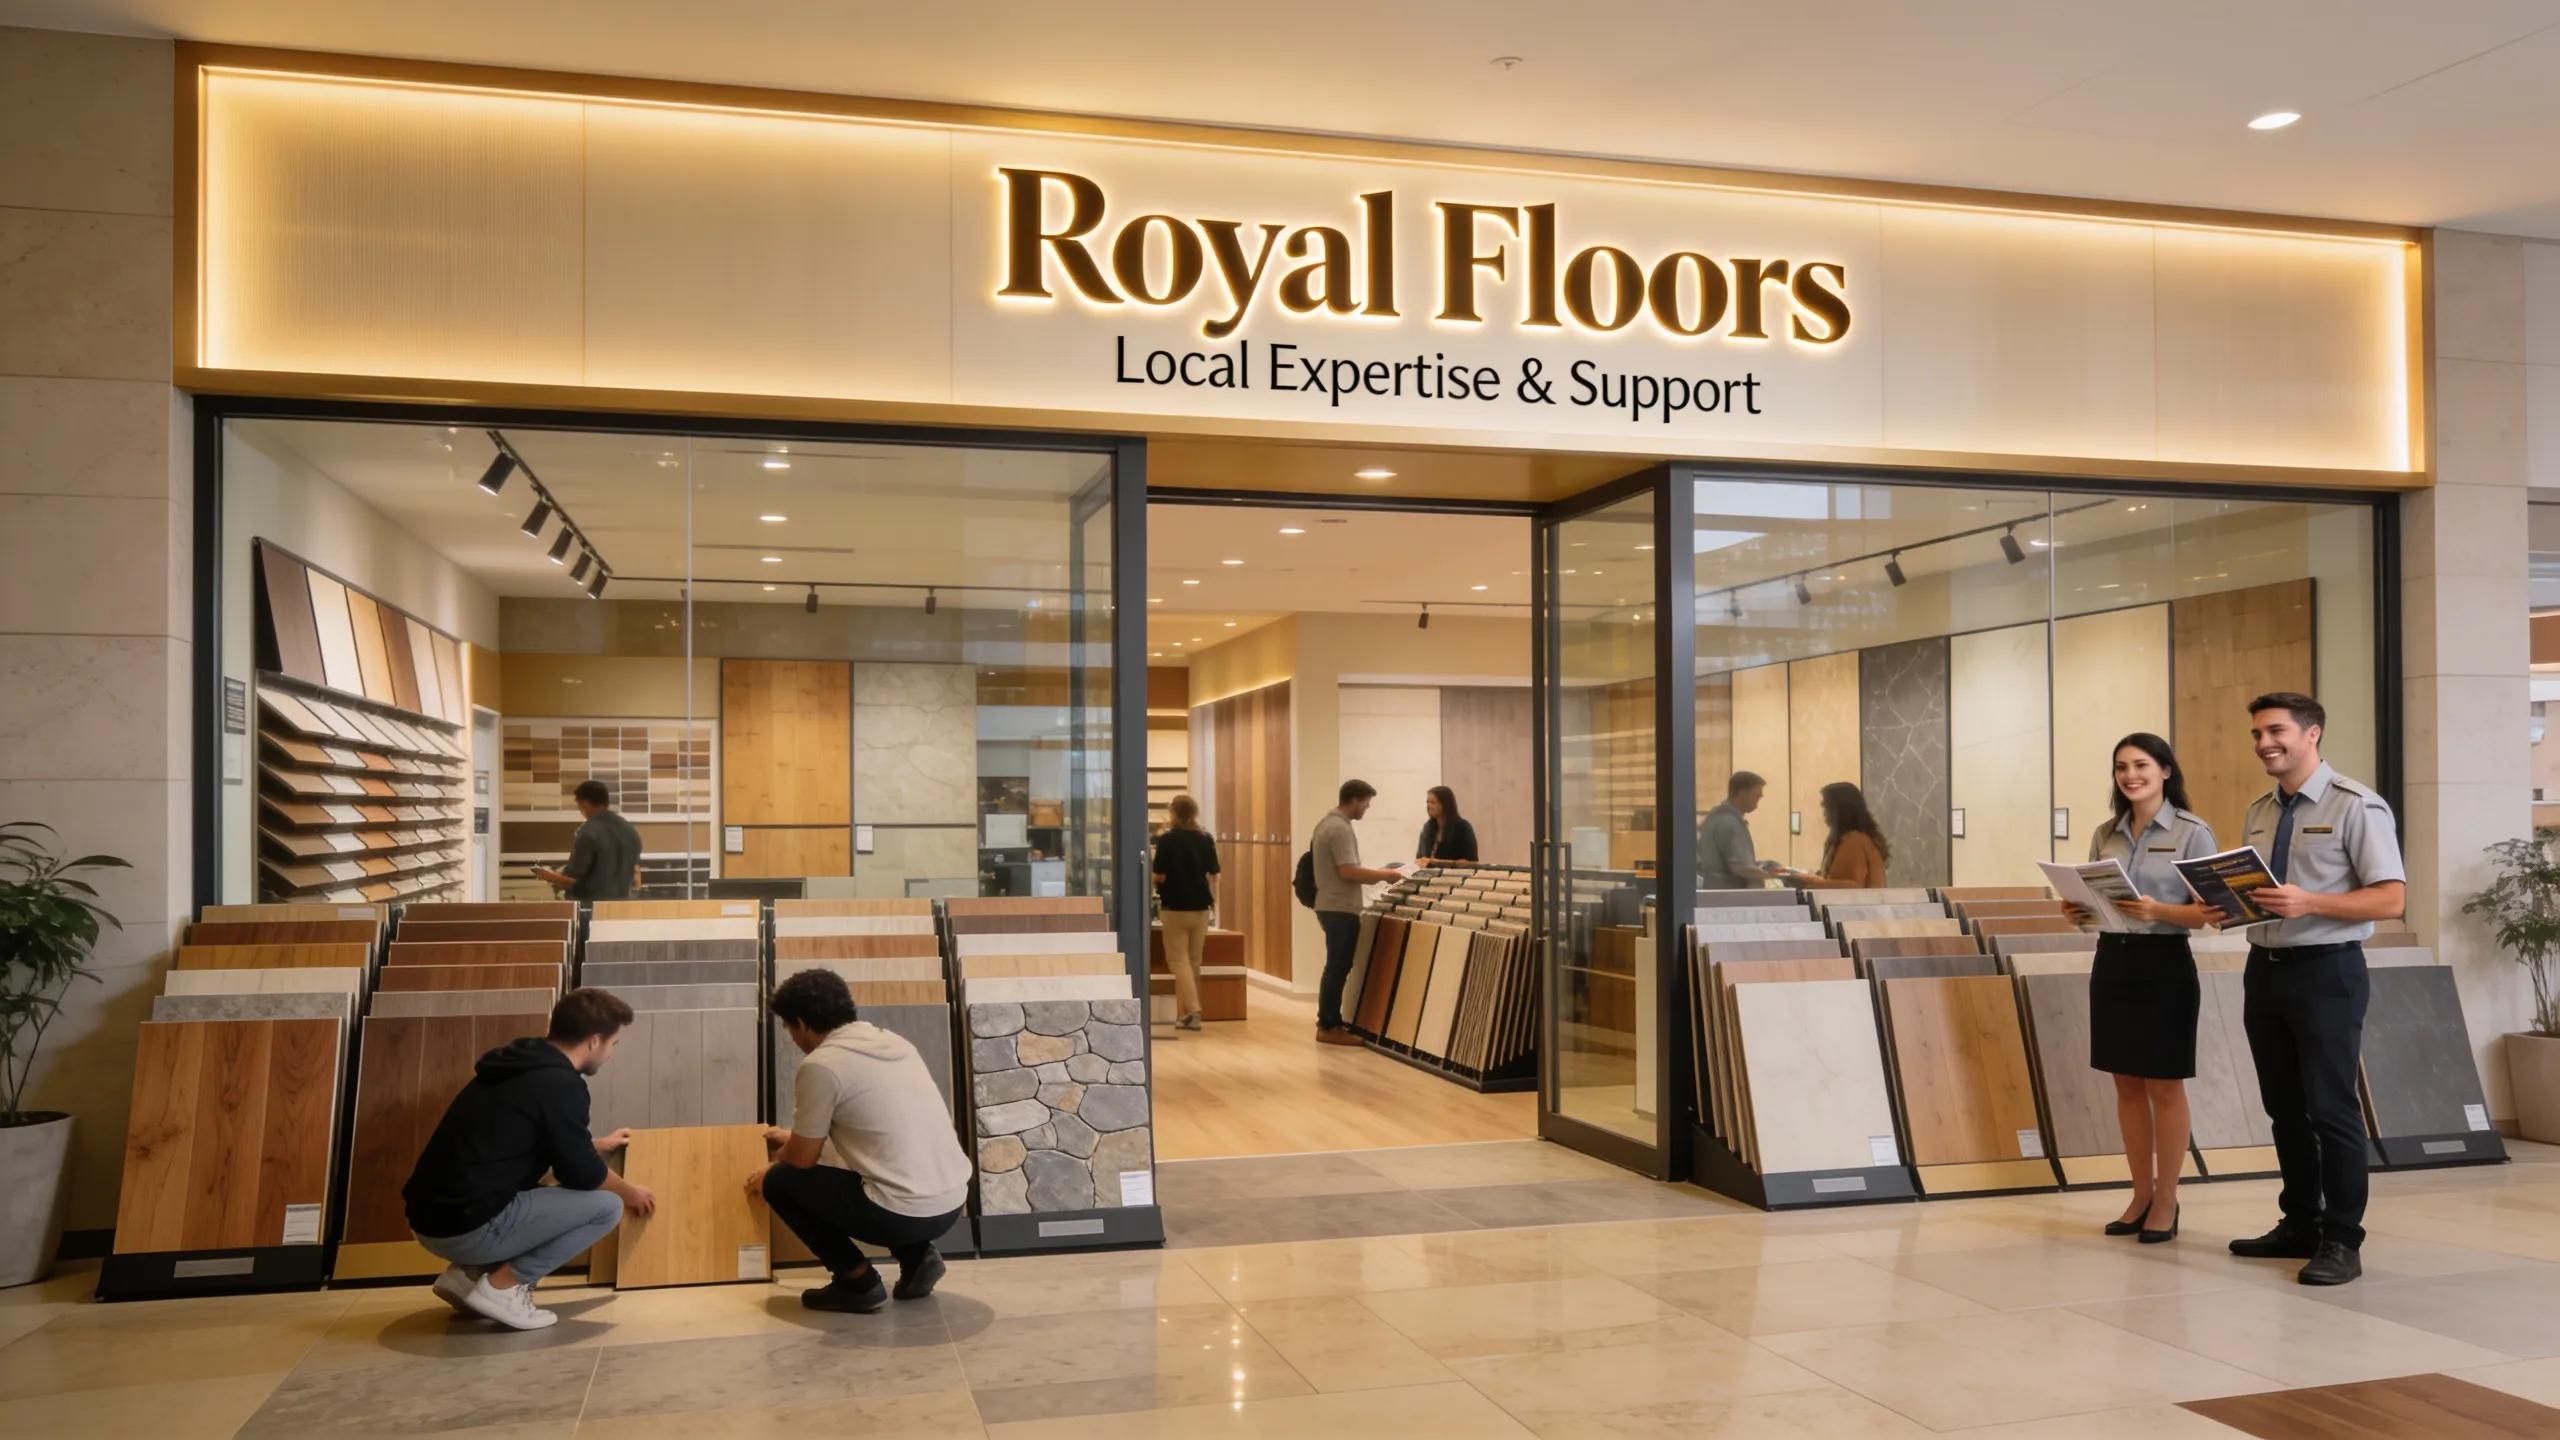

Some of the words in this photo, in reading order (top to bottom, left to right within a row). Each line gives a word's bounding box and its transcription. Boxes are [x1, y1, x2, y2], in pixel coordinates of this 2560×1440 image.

[997, 166, 1401, 338] Royal
[1435, 201, 1852, 344] Floors
[1116, 335, 1251, 390] Local
[1270, 343, 1501, 407] Expertise
[1516, 357, 1557, 405] &
[1570, 359, 1762, 424] Support
